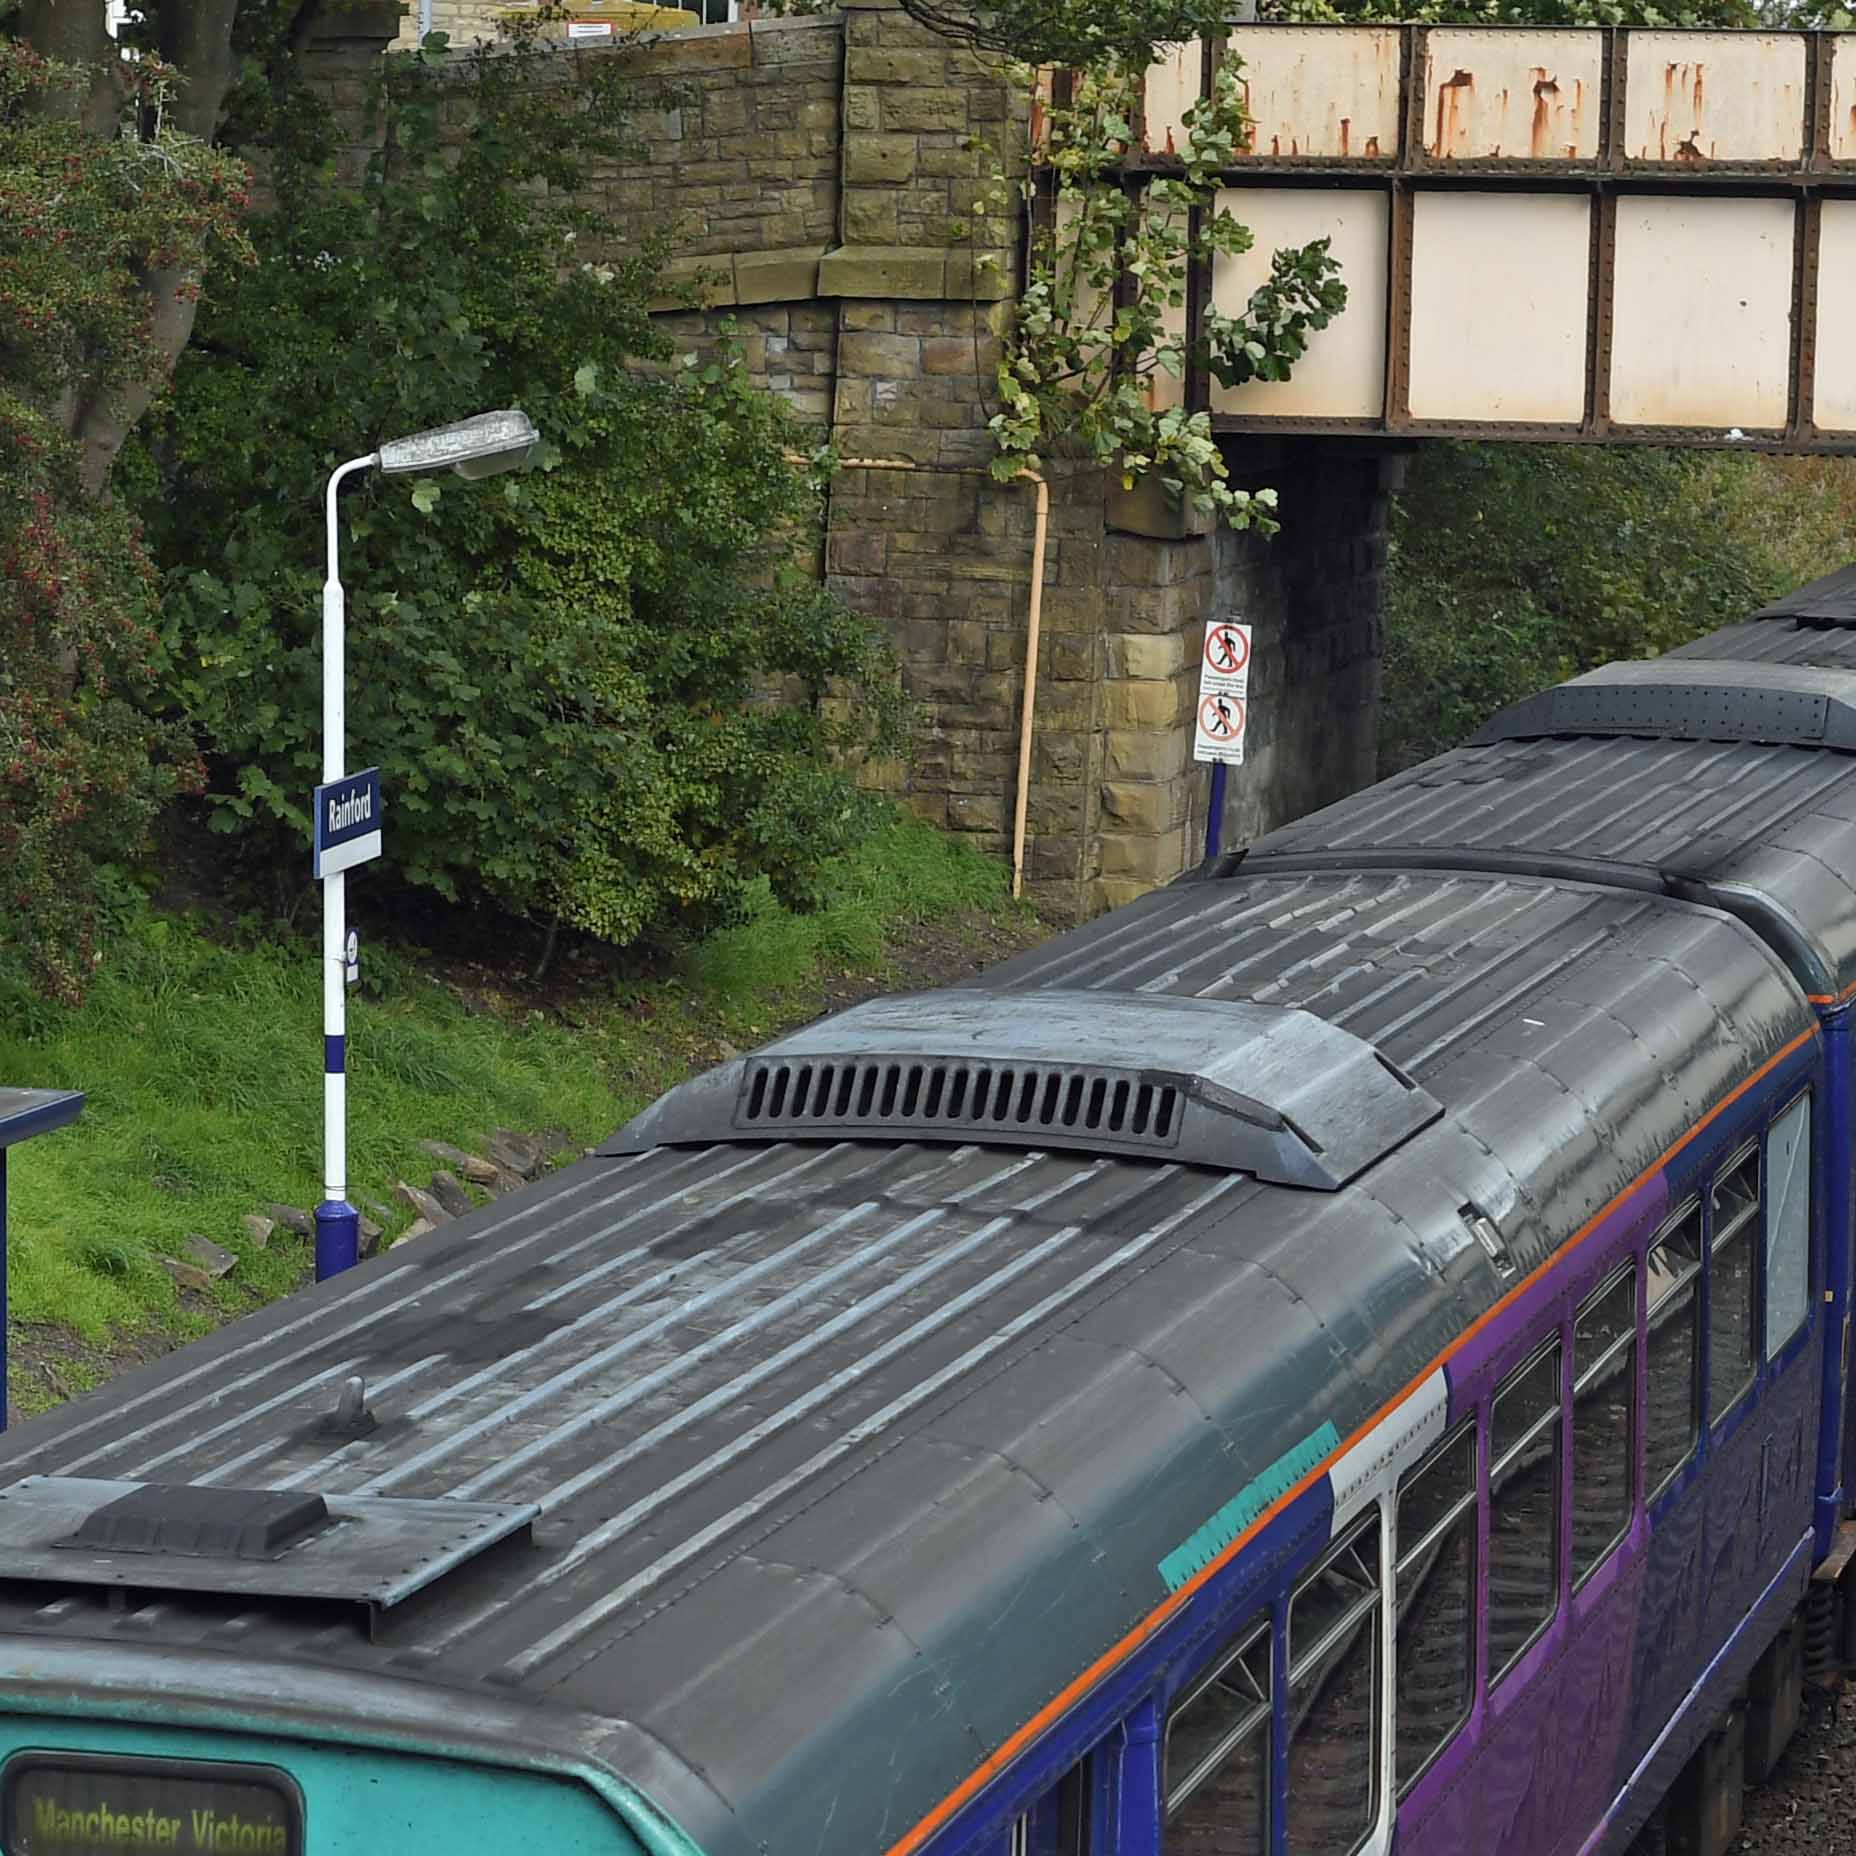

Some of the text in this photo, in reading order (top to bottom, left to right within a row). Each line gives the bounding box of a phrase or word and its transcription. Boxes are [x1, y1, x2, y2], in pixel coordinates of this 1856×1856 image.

[328, 784, 372, 833] Rainford
[32, 1797, 287, 1856] Manchester Victoria
